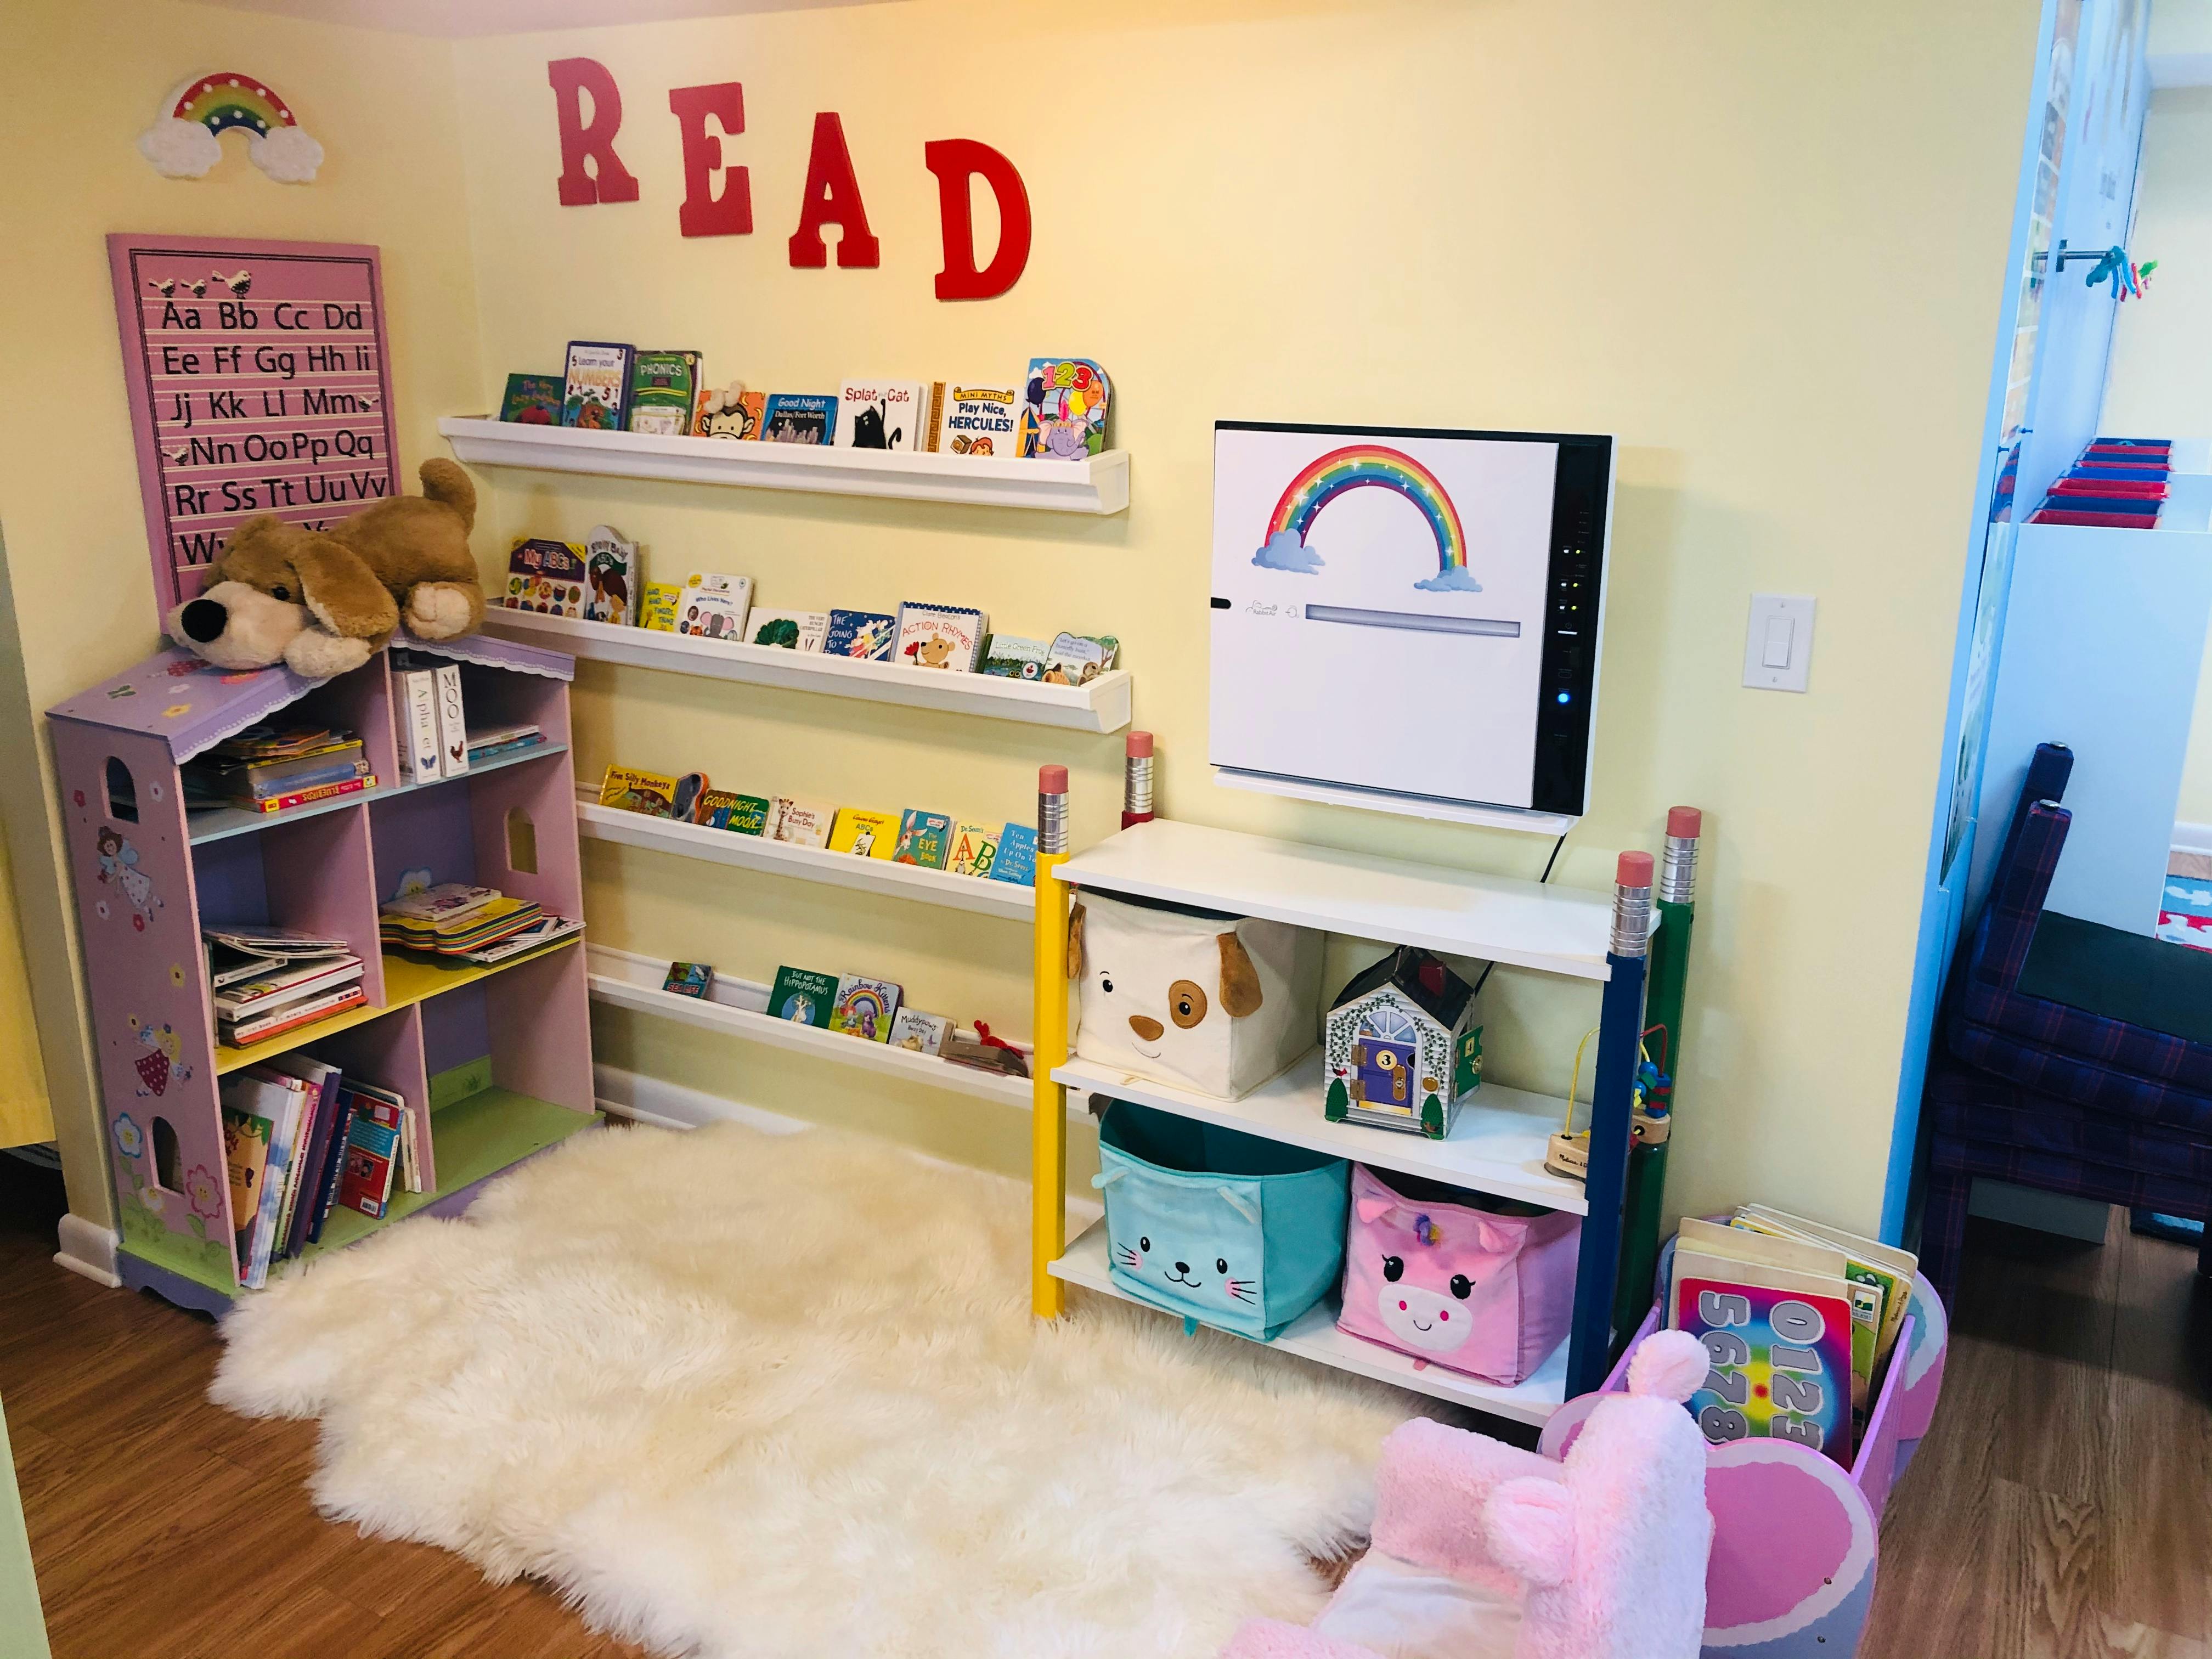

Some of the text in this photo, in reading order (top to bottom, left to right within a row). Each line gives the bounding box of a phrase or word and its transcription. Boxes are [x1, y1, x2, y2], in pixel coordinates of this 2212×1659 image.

[548, 57, 1032, 301] READ
[162, 302, 363, 330] Aa Bb Cc Dd
[163, 345, 371, 380] Ee Ff Gg Hh Ii
[640, 363, 682, 376] PHONICS
[1042, 362, 1093, 391] 123
[845, 387, 878, 402] Splat
[888, 388, 910, 402] Cat
[170, 388, 357, 428] Jj Kk Ll Mm
[778, 398, 826, 410] Good Night
[959, 403, 1006, 417] Play Nice,
[949, 416, 1014, 432] HERCULES!
[190, 430, 374, 465] Nn Oo Pp Qq
[174, 471, 387, 516] Rr Ss Tt Uu Vv
[179, 532, 224, 565] W
[523, 549, 543, 569] My
[833, 613, 849, 625] THE
[828, 626, 853, 639] GOING
[902, 621, 973, 651] ACTION RHYMES
[827, 639, 837, 648] TO
[1012, 642, 1031, 652] Green
[1031, 645, 1046, 657] Frog
[443, 672, 459, 719] MOO
[611, 771, 671, 790] Five Silly Monkeys
[302, 785, 339, 802] BLUEBIRDS
[704, 796, 761, 812] GOODNIGHT
[792, 808, 815, 820] Sophie's
[729, 815, 762, 829] MOON
[788, 816, 815, 828] Busy Day
[856, 823, 873, 832] ABCs
[1011, 830, 1024, 840] Ten
[918, 838, 938, 851] EYE
[1010, 839, 1035, 853] Apples
[920, 851, 937, 862] BOOK
[1015, 851, 1025, 861] On
[783, 975, 828, 995] HIPPOPOTAMUS
[791, 970, 802, 979] BUT
[815, 976, 826, 985] THE
[838, 979, 890, 1013] Rainbow Kittens
[1381, 1054, 1391, 1065] 3
